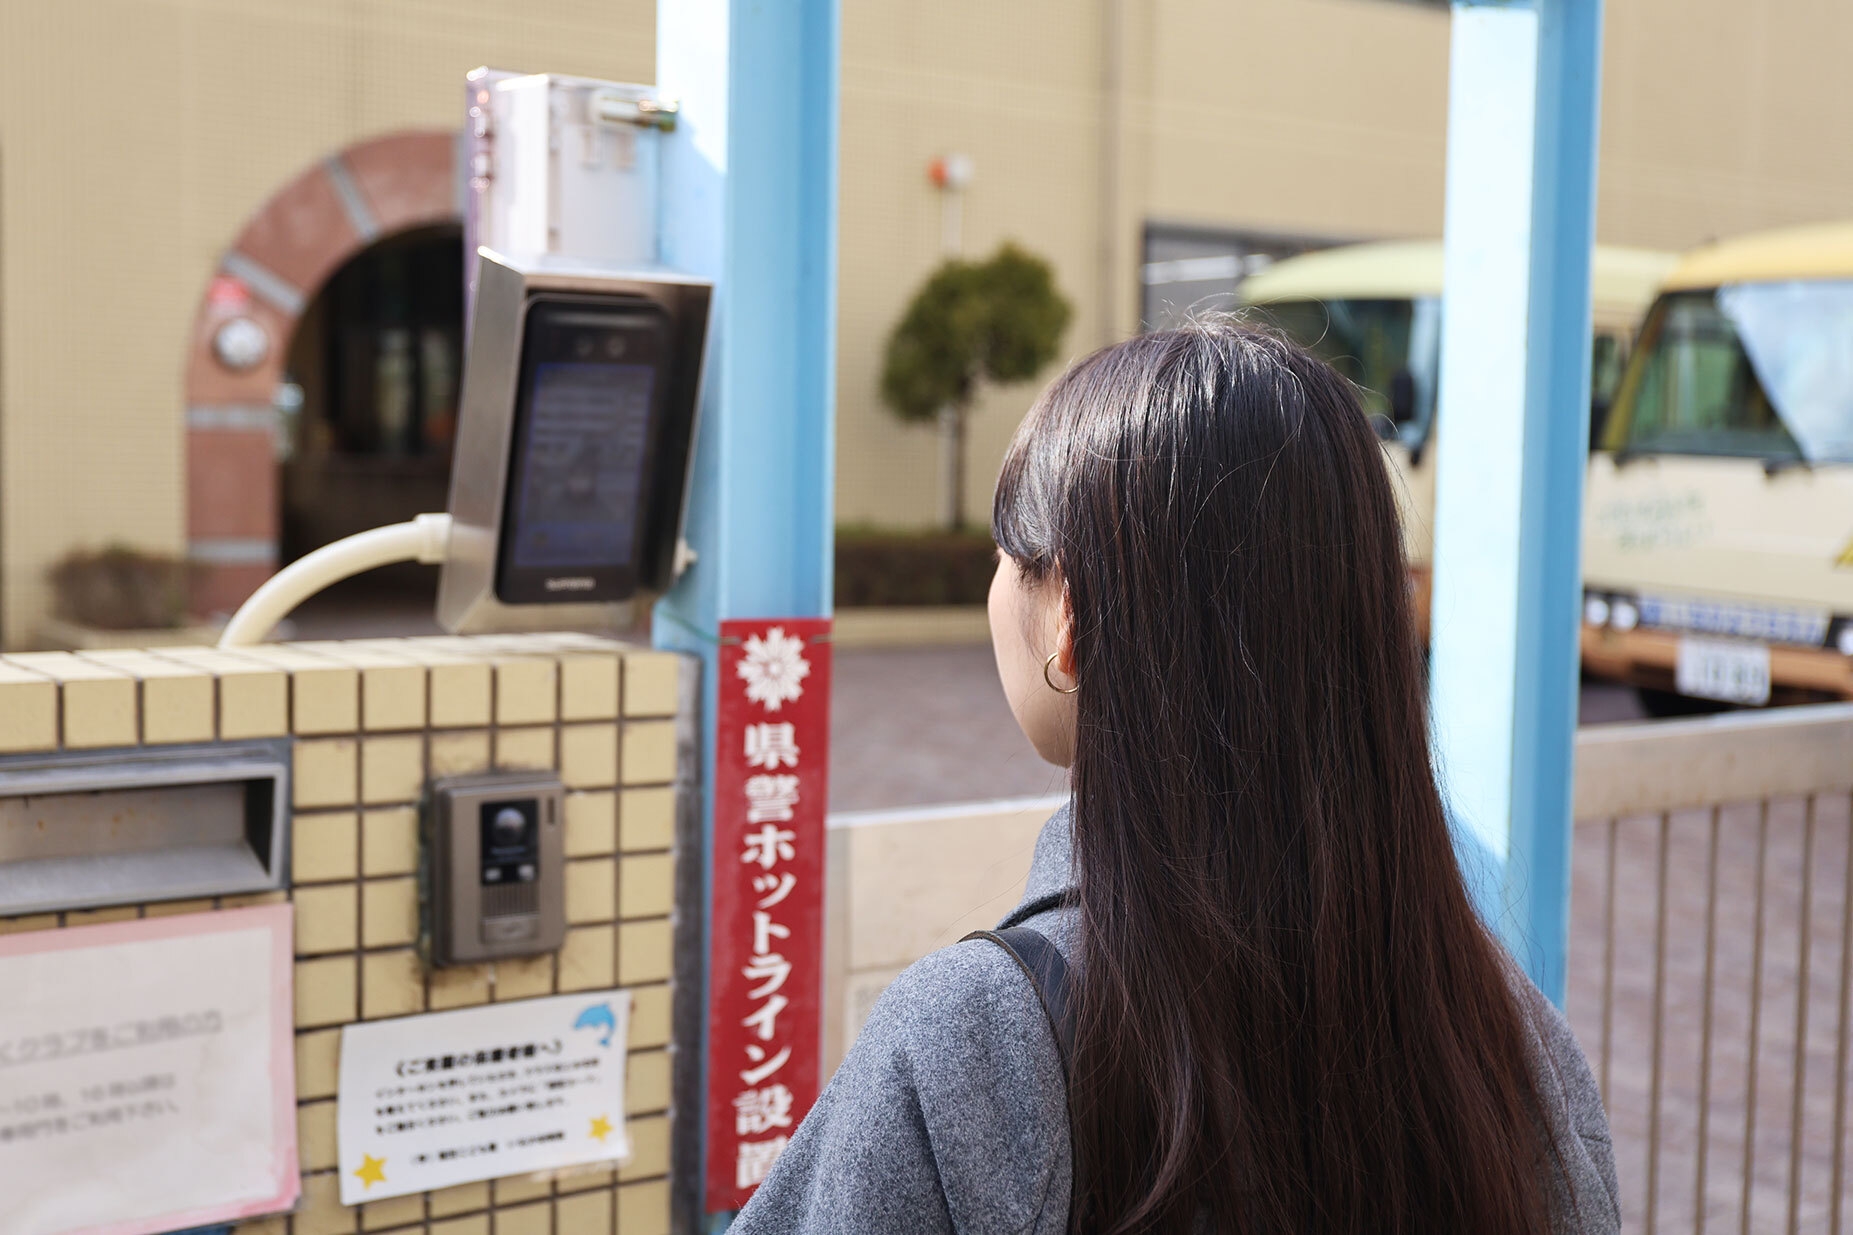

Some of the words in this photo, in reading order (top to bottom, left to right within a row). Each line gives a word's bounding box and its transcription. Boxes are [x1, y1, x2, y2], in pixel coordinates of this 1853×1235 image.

[730, 722, 800, 1190] 県警ホットライン設置
